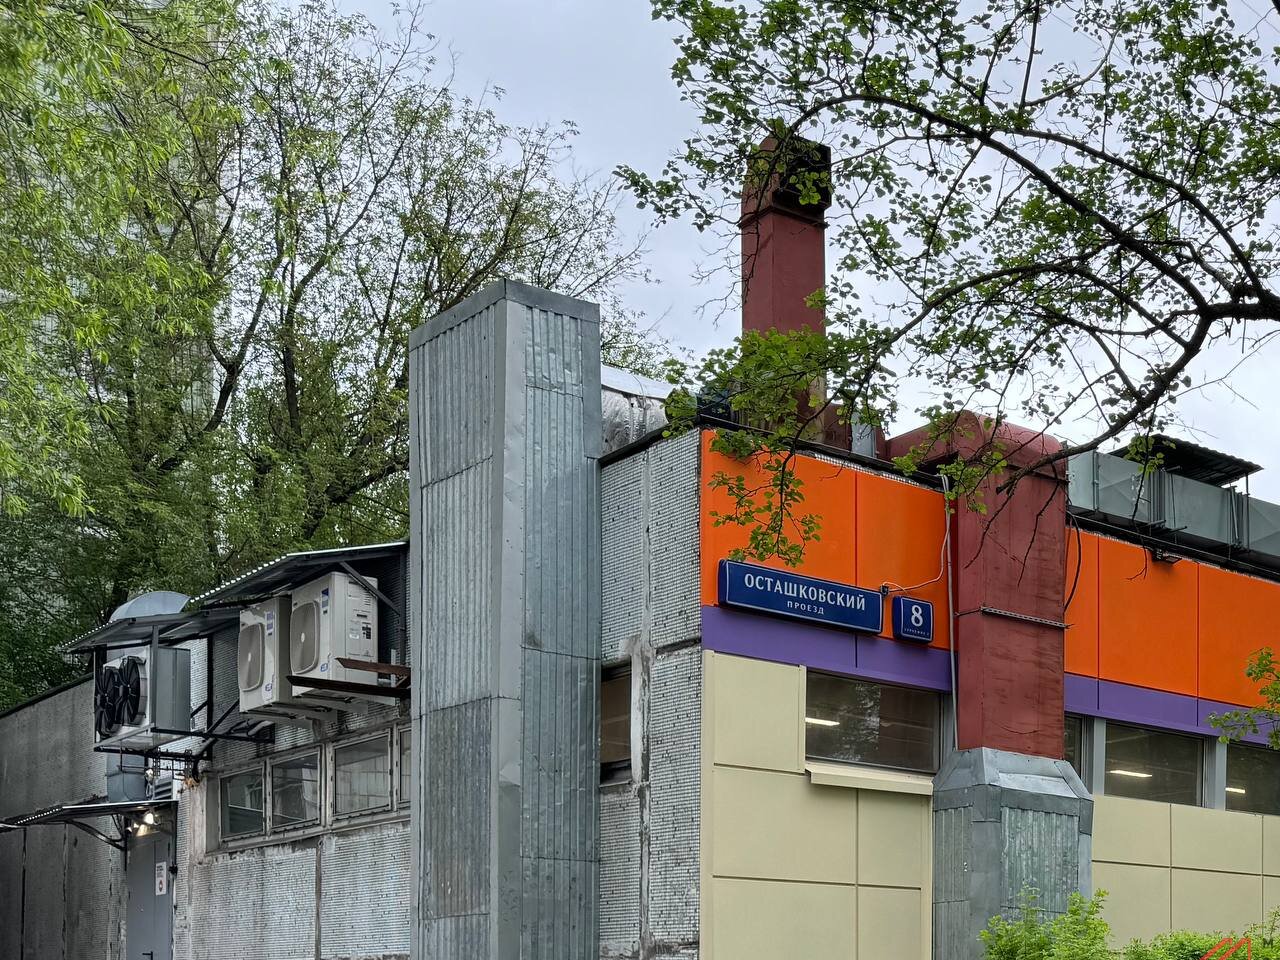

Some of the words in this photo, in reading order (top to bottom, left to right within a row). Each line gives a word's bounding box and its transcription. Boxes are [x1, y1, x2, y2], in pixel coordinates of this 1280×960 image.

[744, 573, 866, 611] ОСТАШКОВСКИЙ
[787, 600, 825, 615] ПРОЕЗД
[911, 604, 923, 627] 8
